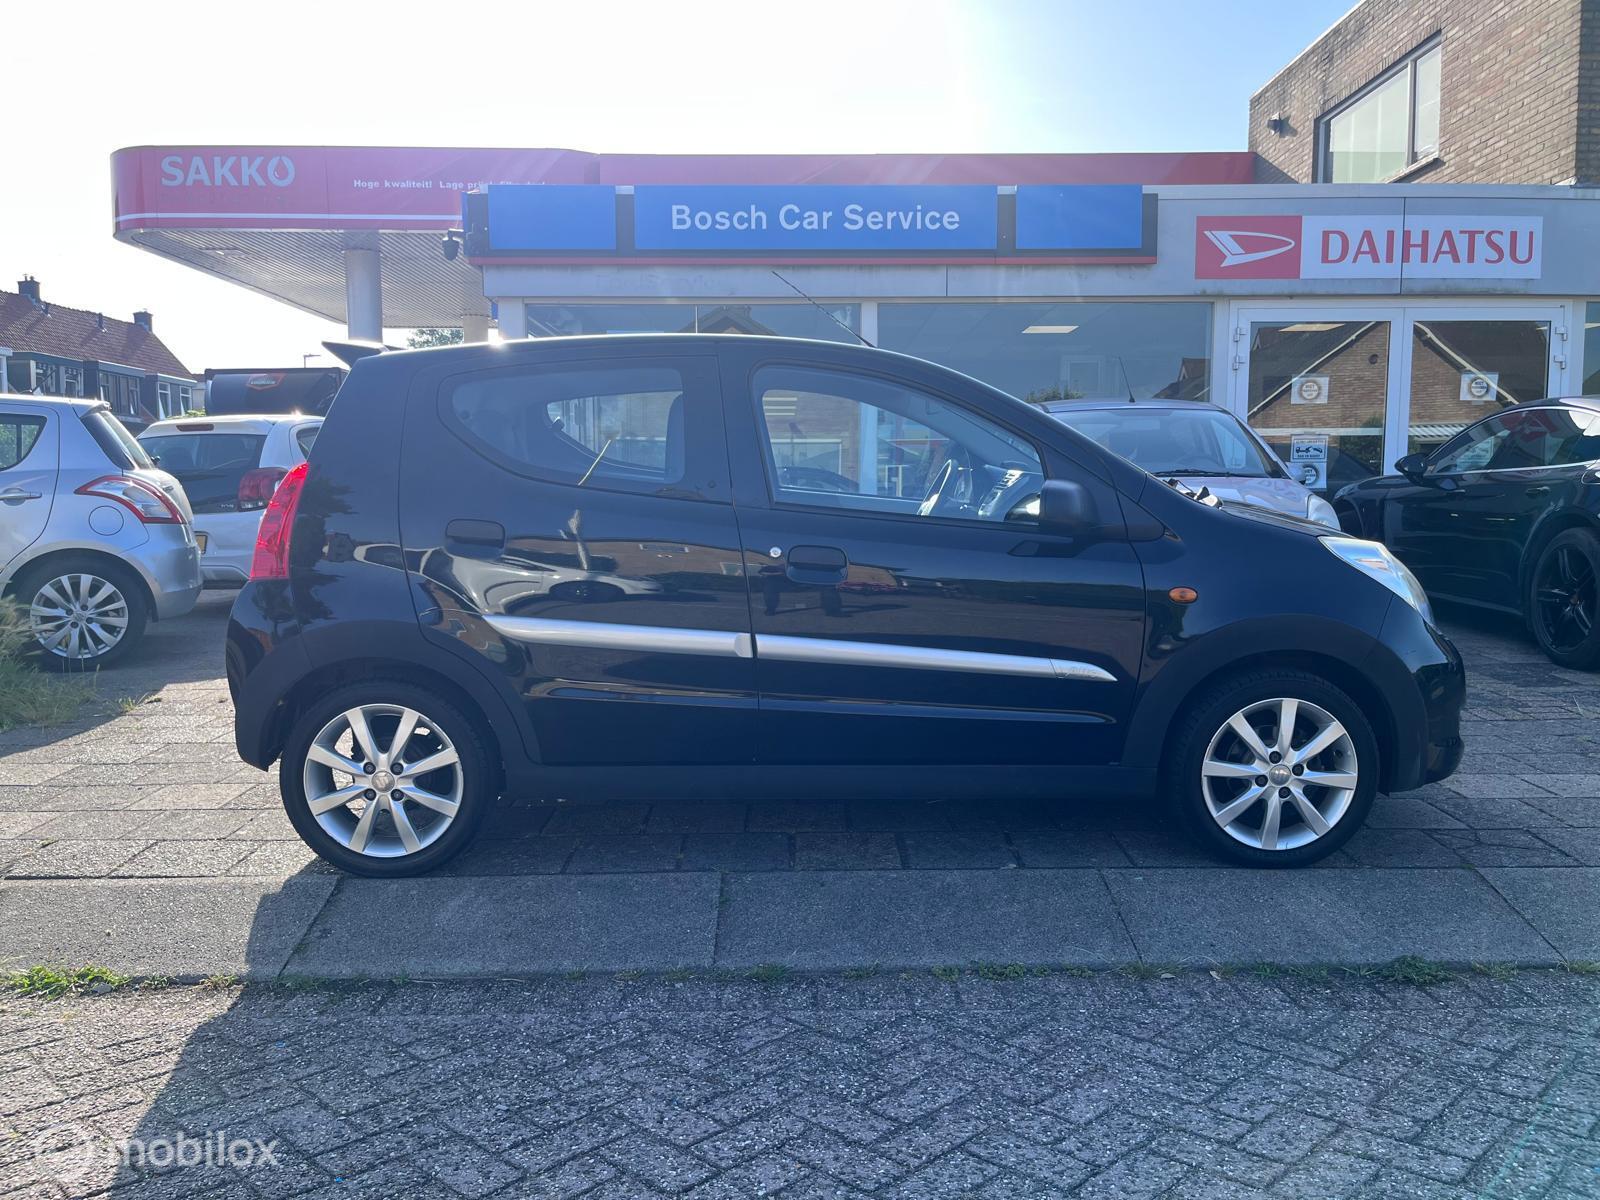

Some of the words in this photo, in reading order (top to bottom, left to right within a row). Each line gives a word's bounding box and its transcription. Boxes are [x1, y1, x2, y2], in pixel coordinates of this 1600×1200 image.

[160, 155, 296, 187] SAKKO
[353, 179, 380, 190] Hoge
[440, 180, 464, 191] Lage
[671, 204, 767, 231] Bosch
[779, 203, 833, 231] Car
[843, 203, 960, 231] Service
[1320, 229, 1534, 265] DAIHATSU
